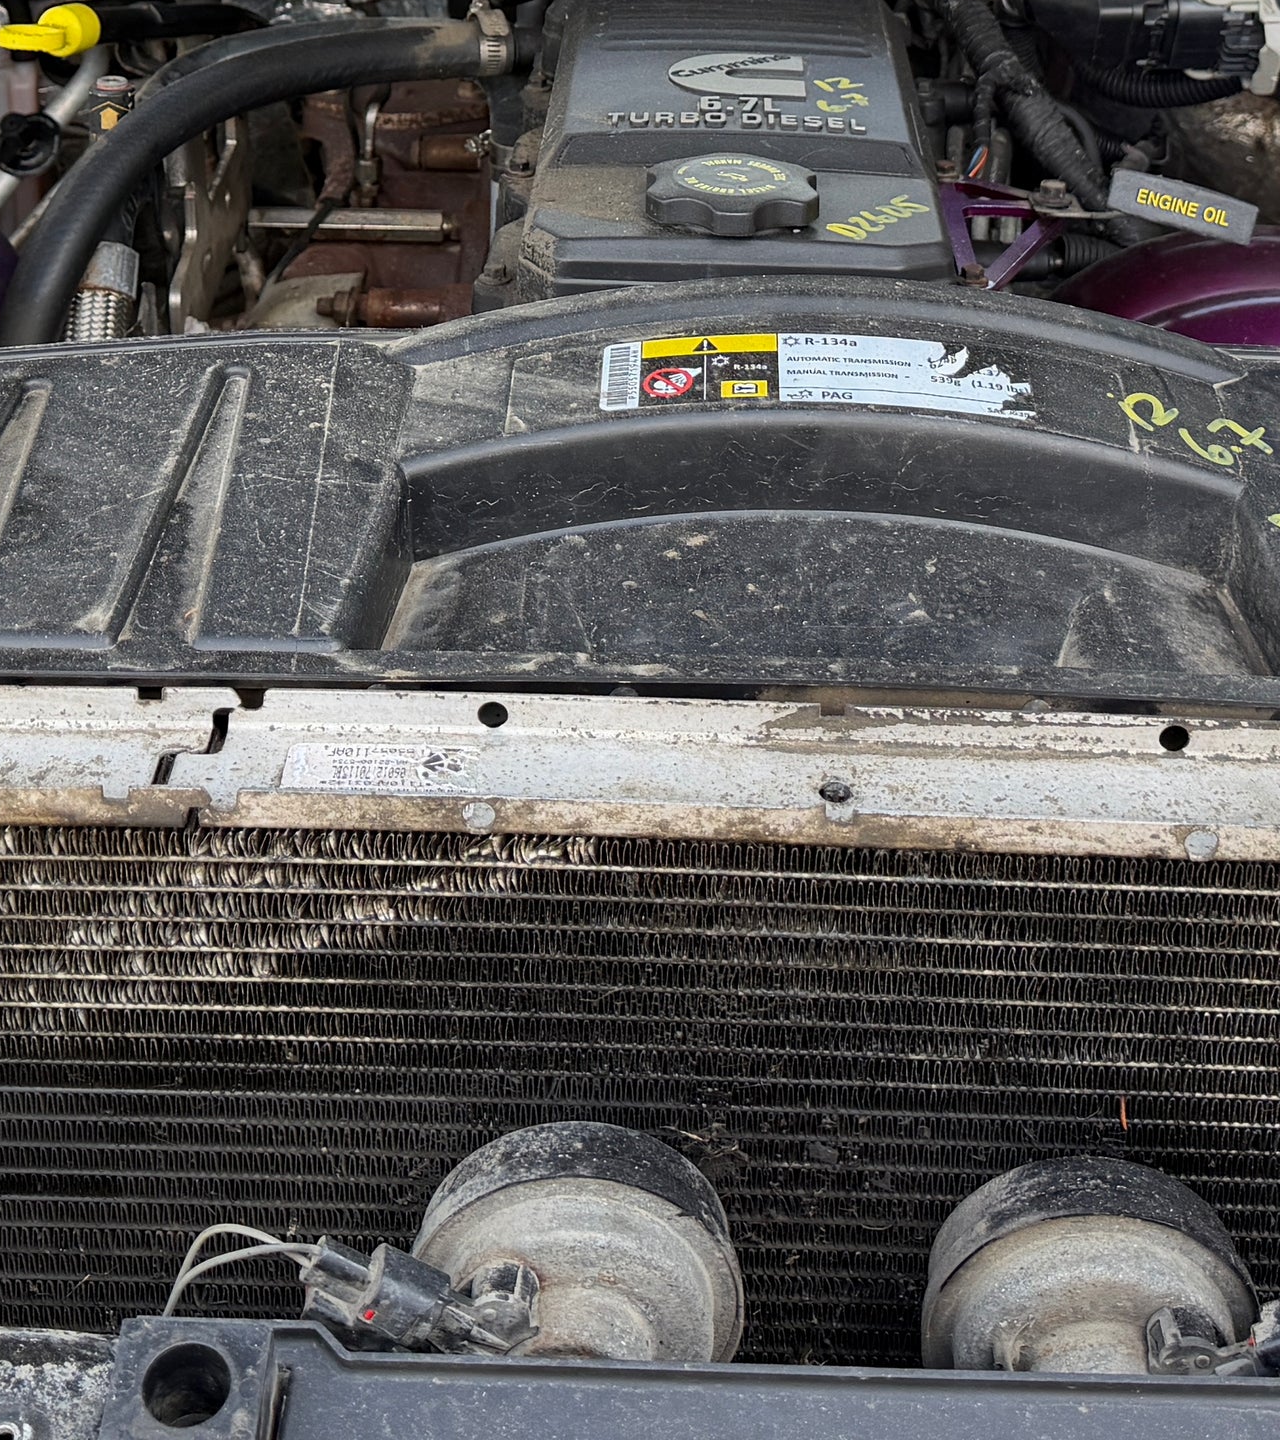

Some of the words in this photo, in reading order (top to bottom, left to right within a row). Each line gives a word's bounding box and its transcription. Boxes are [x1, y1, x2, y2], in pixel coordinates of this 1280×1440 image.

[671, 54, 791, 77] Cummins
[699, 95, 781, 113] 6.7L
[608, 111, 727, 127] TURBO
[742, 112, 867, 133] DIESEL
[1136, 188, 1200, 218] ENGINE
[1203, 206, 1230, 227] OIL
[805, 337, 858, 347] R-134a
[733, 363, 768, 371] R-134a
[842, 357, 912, 368] TRANSMISSION
[829, 370, 899, 379] TRANSMISSION
[930, 375, 961, 387] 539g
[971, 379, 1003, 390] (1.19
[821, 391, 853, 400] PAG
